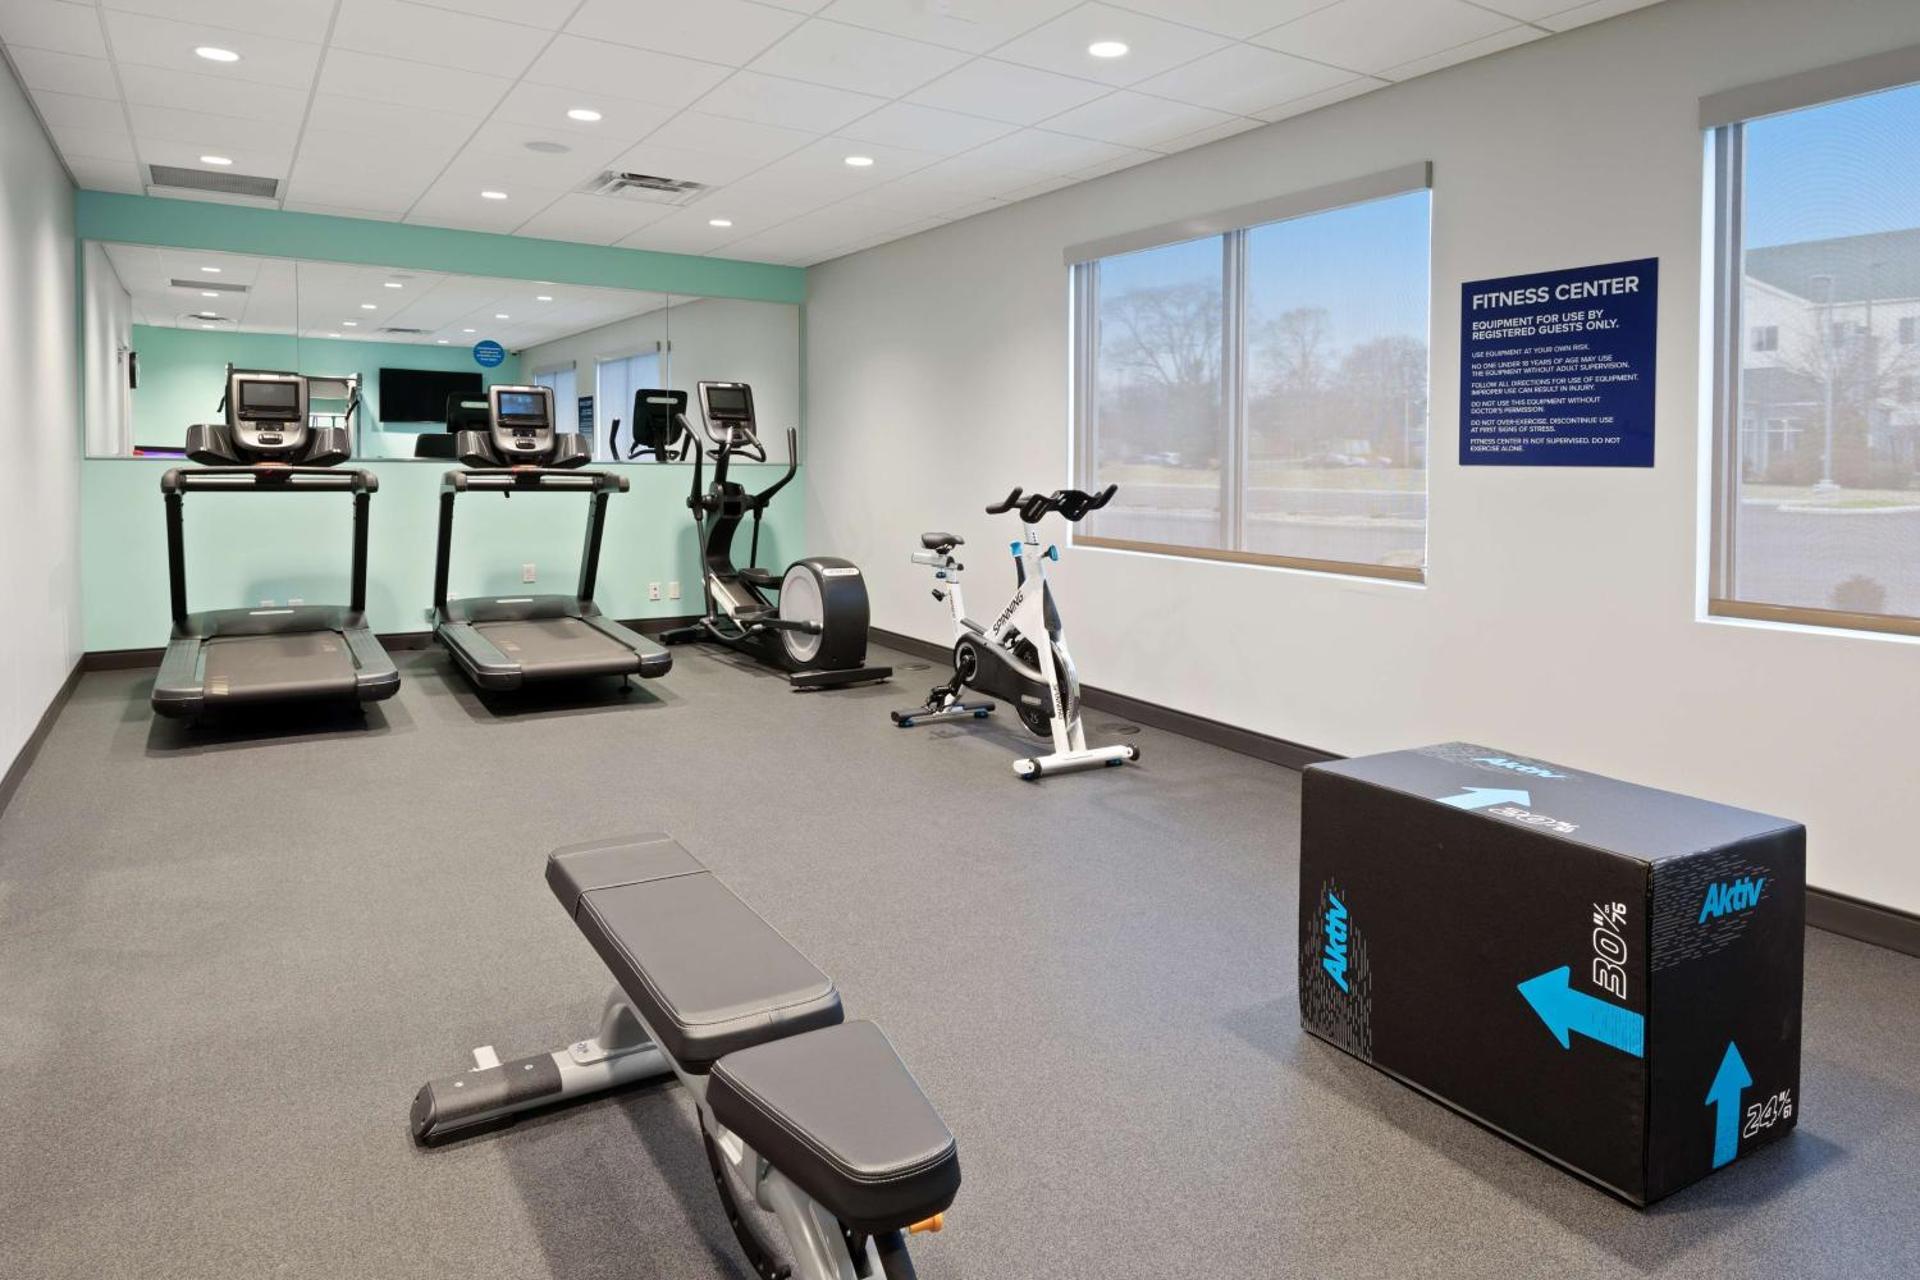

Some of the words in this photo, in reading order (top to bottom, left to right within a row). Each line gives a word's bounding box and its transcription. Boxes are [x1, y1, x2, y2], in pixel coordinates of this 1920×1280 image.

[1472, 286, 1550, 310] FITNESS
[1555, 276, 1639, 301] CENTER
[1472, 316, 1533, 331] EQUIPMENT
[1536, 313, 1559, 325] FOR
[1562, 311, 1585, 322] USE
[1588, 309, 1604, 320] BY
[1472, 326, 1536, 341] REGISTERED
[1538, 321, 1583, 334] GUESTS
[1586, 318, 1620, 331] ONLY.
[1485, 348, 1522, 358] EQUIPMENT
[1534, 346, 1553, 354] YOUR
[1554, 345, 1571, 353] OWN
[1471, 362, 1482, 370] NO
[1498, 360, 1520, 368] UNDER
[1580, 355, 1597, 363] MAY
[1598, 354, 1613, 362] USE
[1485, 368, 1522, 376] EQUIPMENT
[1523, 366, 1554, 374] WITHOUT
[1556, 364, 1578, 372] ADULT
[1580, 361, 1630, 371] SUPERVISION.
[1511, 378, 1550, 387] DIRECTIONS
[1551, 377, 1566, 385] FOR
[1583, 375, 1594, 383] OF
[1595, 373, 1639, 383] EQUIPMENT.
[1471, 388, 1503, 396] IMPROPER
[1504, 387, 1517, 395] USE
[1534, 385, 1558, 393] RESULT
[1569, 383, 1596, 391] INJURY.
[1526, 397, 1566, 406] EQUIPMENT
[1568, 396, 1601, 404] WITHOUT
[1550, 416, 1597, 425] DISCONTINUE
[1604, 436, 1621, 444] NOT
[992, 590, 1024, 636] SPINNING
[1698, 876, 1767, 924] Aktiv
[1322, 890, 1349, 994] Aktiv
